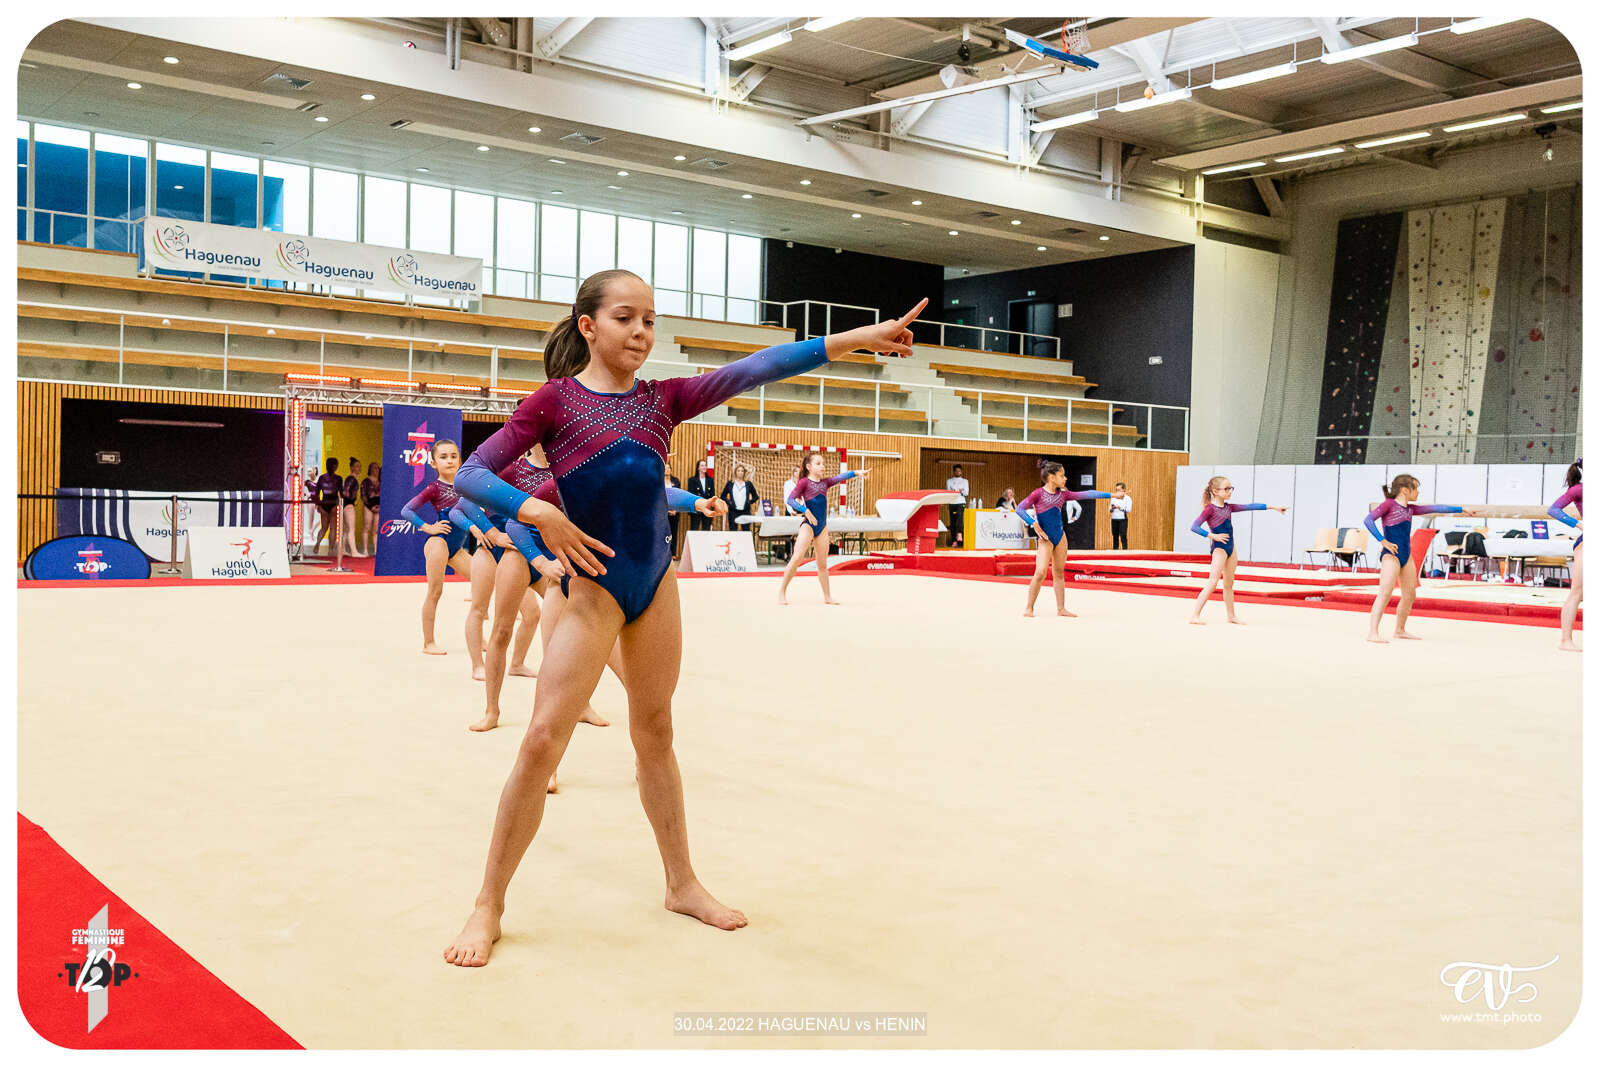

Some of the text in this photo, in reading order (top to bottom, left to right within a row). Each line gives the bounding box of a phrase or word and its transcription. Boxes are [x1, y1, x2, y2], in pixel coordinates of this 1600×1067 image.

[184, 247, 261, 268] Haguenau
[304, 261, 374, 280] Haguenau
[414, 274, 476, 292] Haguenau
